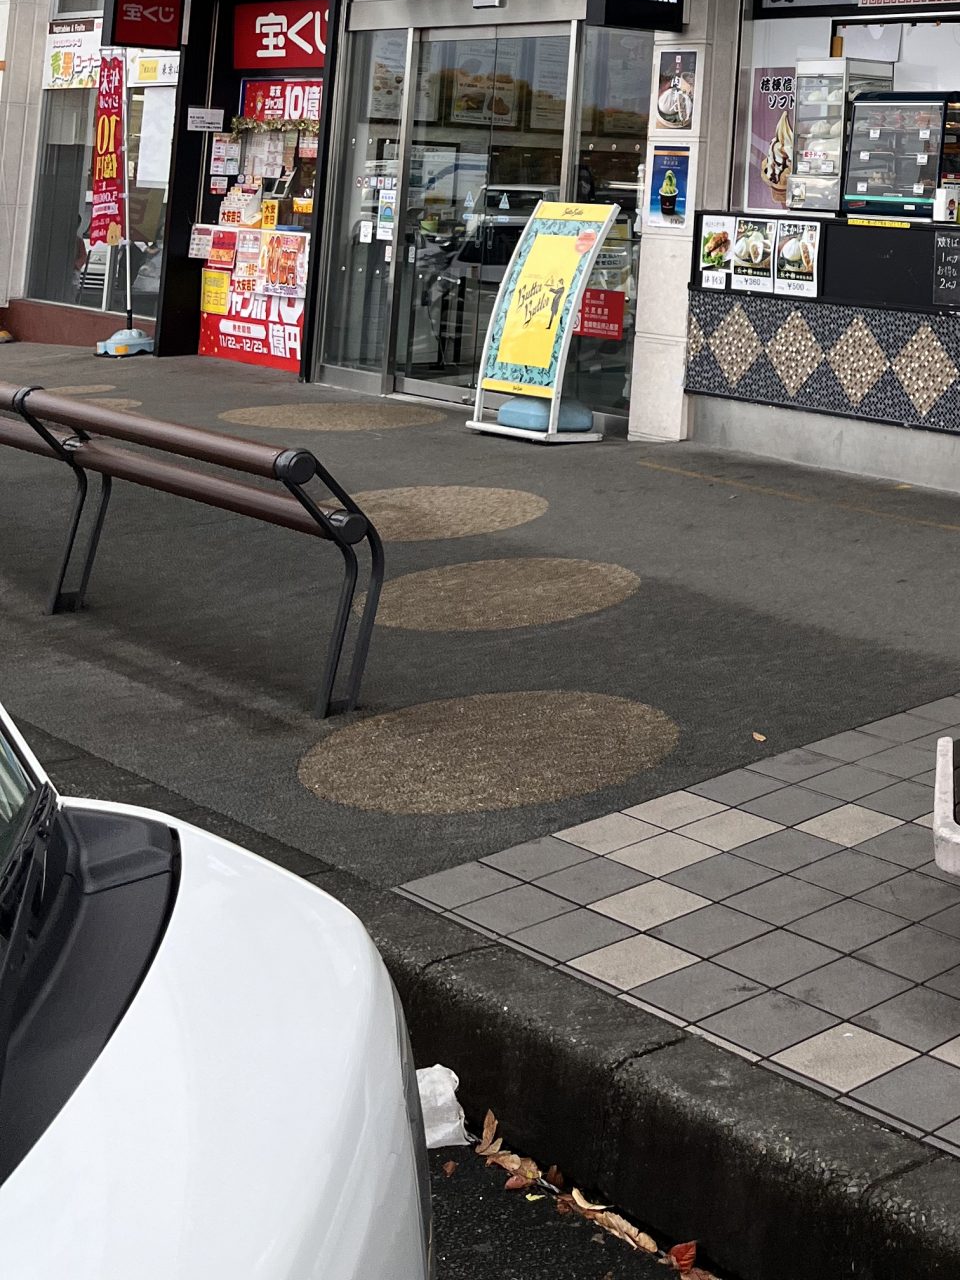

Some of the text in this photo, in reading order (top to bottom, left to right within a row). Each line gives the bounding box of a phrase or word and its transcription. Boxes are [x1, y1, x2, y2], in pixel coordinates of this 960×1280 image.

[122, 3, 174, 23] 宝くじ
[268, 322, 301, 360] 億円
